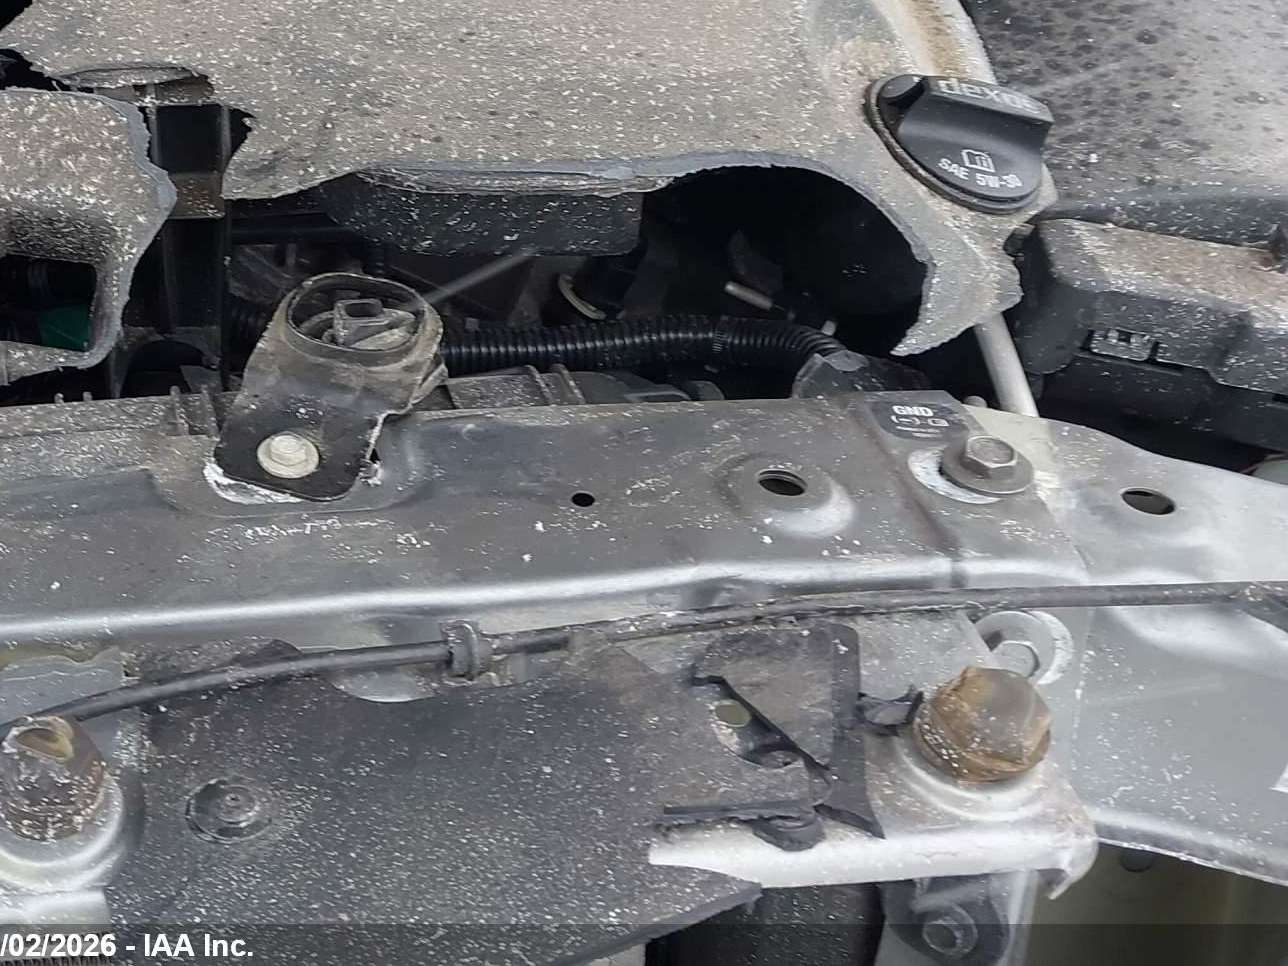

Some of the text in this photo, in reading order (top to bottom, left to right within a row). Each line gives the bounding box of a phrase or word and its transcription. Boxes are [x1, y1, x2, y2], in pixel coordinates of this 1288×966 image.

[938, 78, 1041, 115] dexos
[938, 157, 1023, 189] SAE 5W-30
[892, 405, 934, 417] GND
